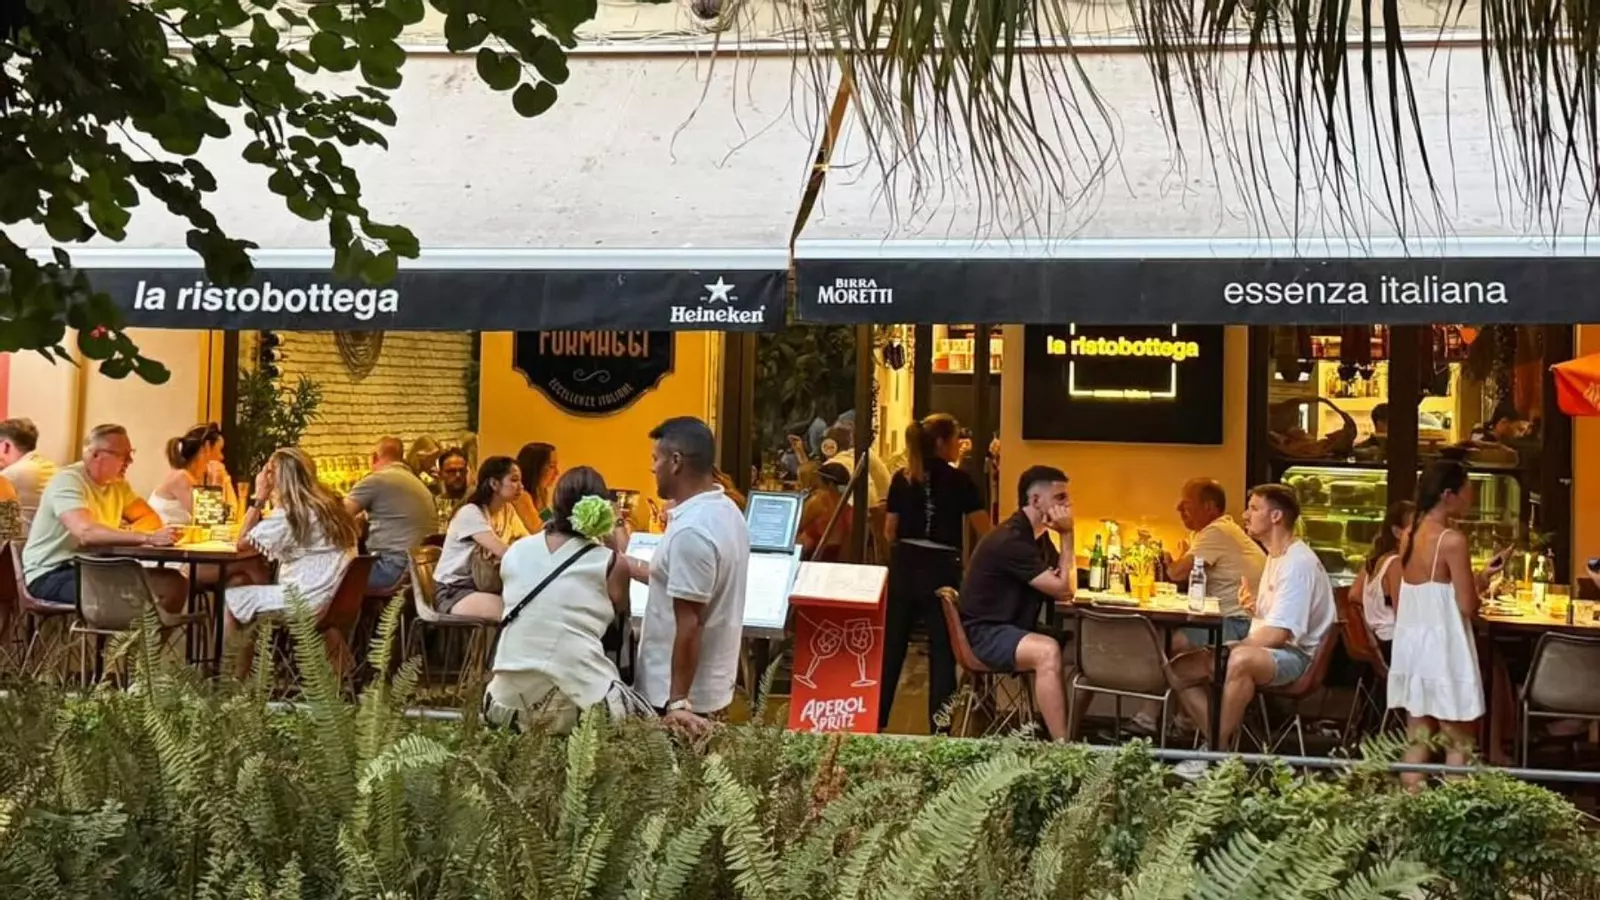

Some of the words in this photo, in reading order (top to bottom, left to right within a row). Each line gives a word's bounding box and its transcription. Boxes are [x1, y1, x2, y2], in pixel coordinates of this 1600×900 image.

[835, 277, 878, 288] BIRRA
[1223, 279, 1369, 304] essenza
[1380, 275, 1508, 304] italiana
[133, 280, 165, 310] la
[176, 281, 399, 320] ristobottega
[817, 286, 893, 304] MORETTI
[669, 305, 765, 323] Heineken
[1047, 335, 1066, 355] la
[1070, 335, 1199, 361] ristobottega
[800, 696, 867, 722] APEROL
[809, 713, 855, 733] SPRITZ
